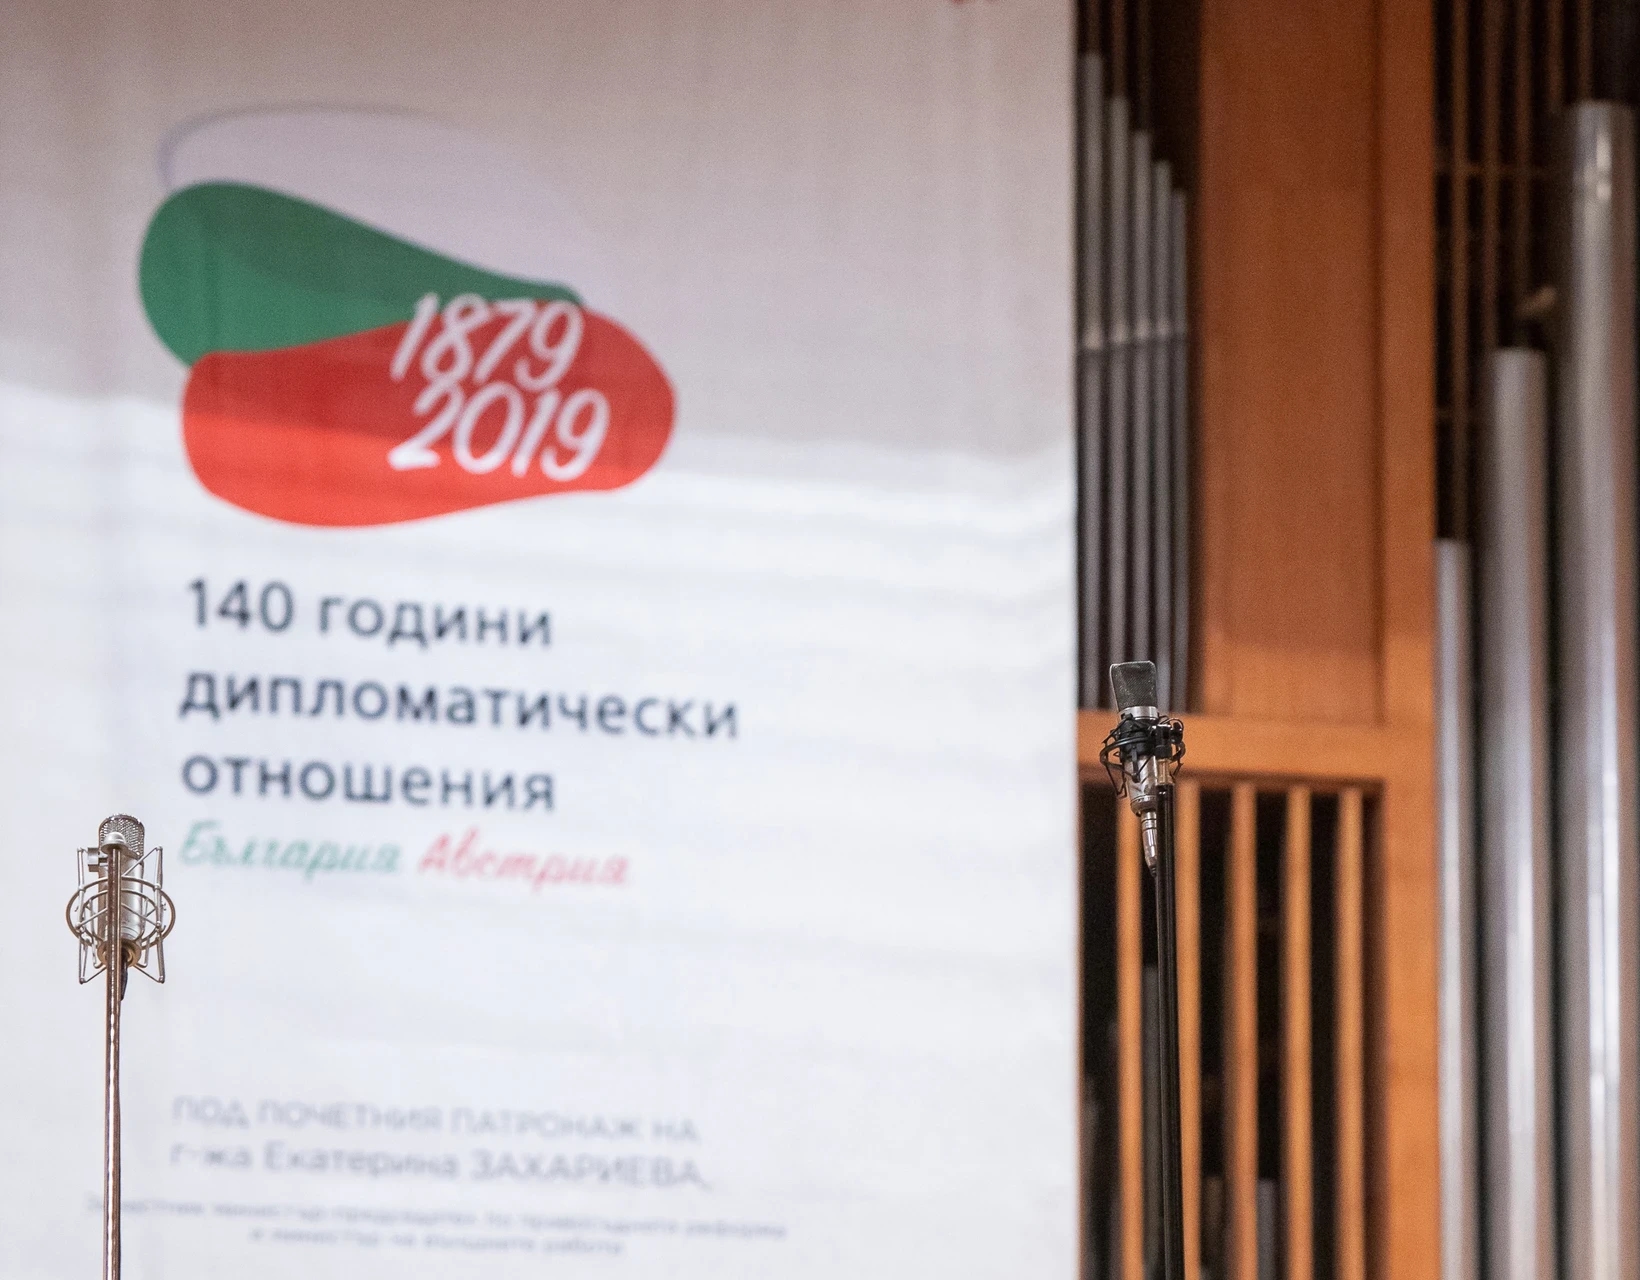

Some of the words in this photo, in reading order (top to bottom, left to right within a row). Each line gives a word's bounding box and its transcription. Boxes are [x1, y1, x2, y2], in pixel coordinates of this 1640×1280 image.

[390, 293, 583, 391] 1879
[388, 380, 610, 482] 2019
[189, 577, 295, 633] 140
[317, 595, 552, 650] години
[178, 671, 738, 738] дипломатически
[181, 753, 556, 810] отношения
[179, 821, 400, 882] България
[418, 827, 629, 892] Австрия
[172, 1095, 249, 1129] ПОД
